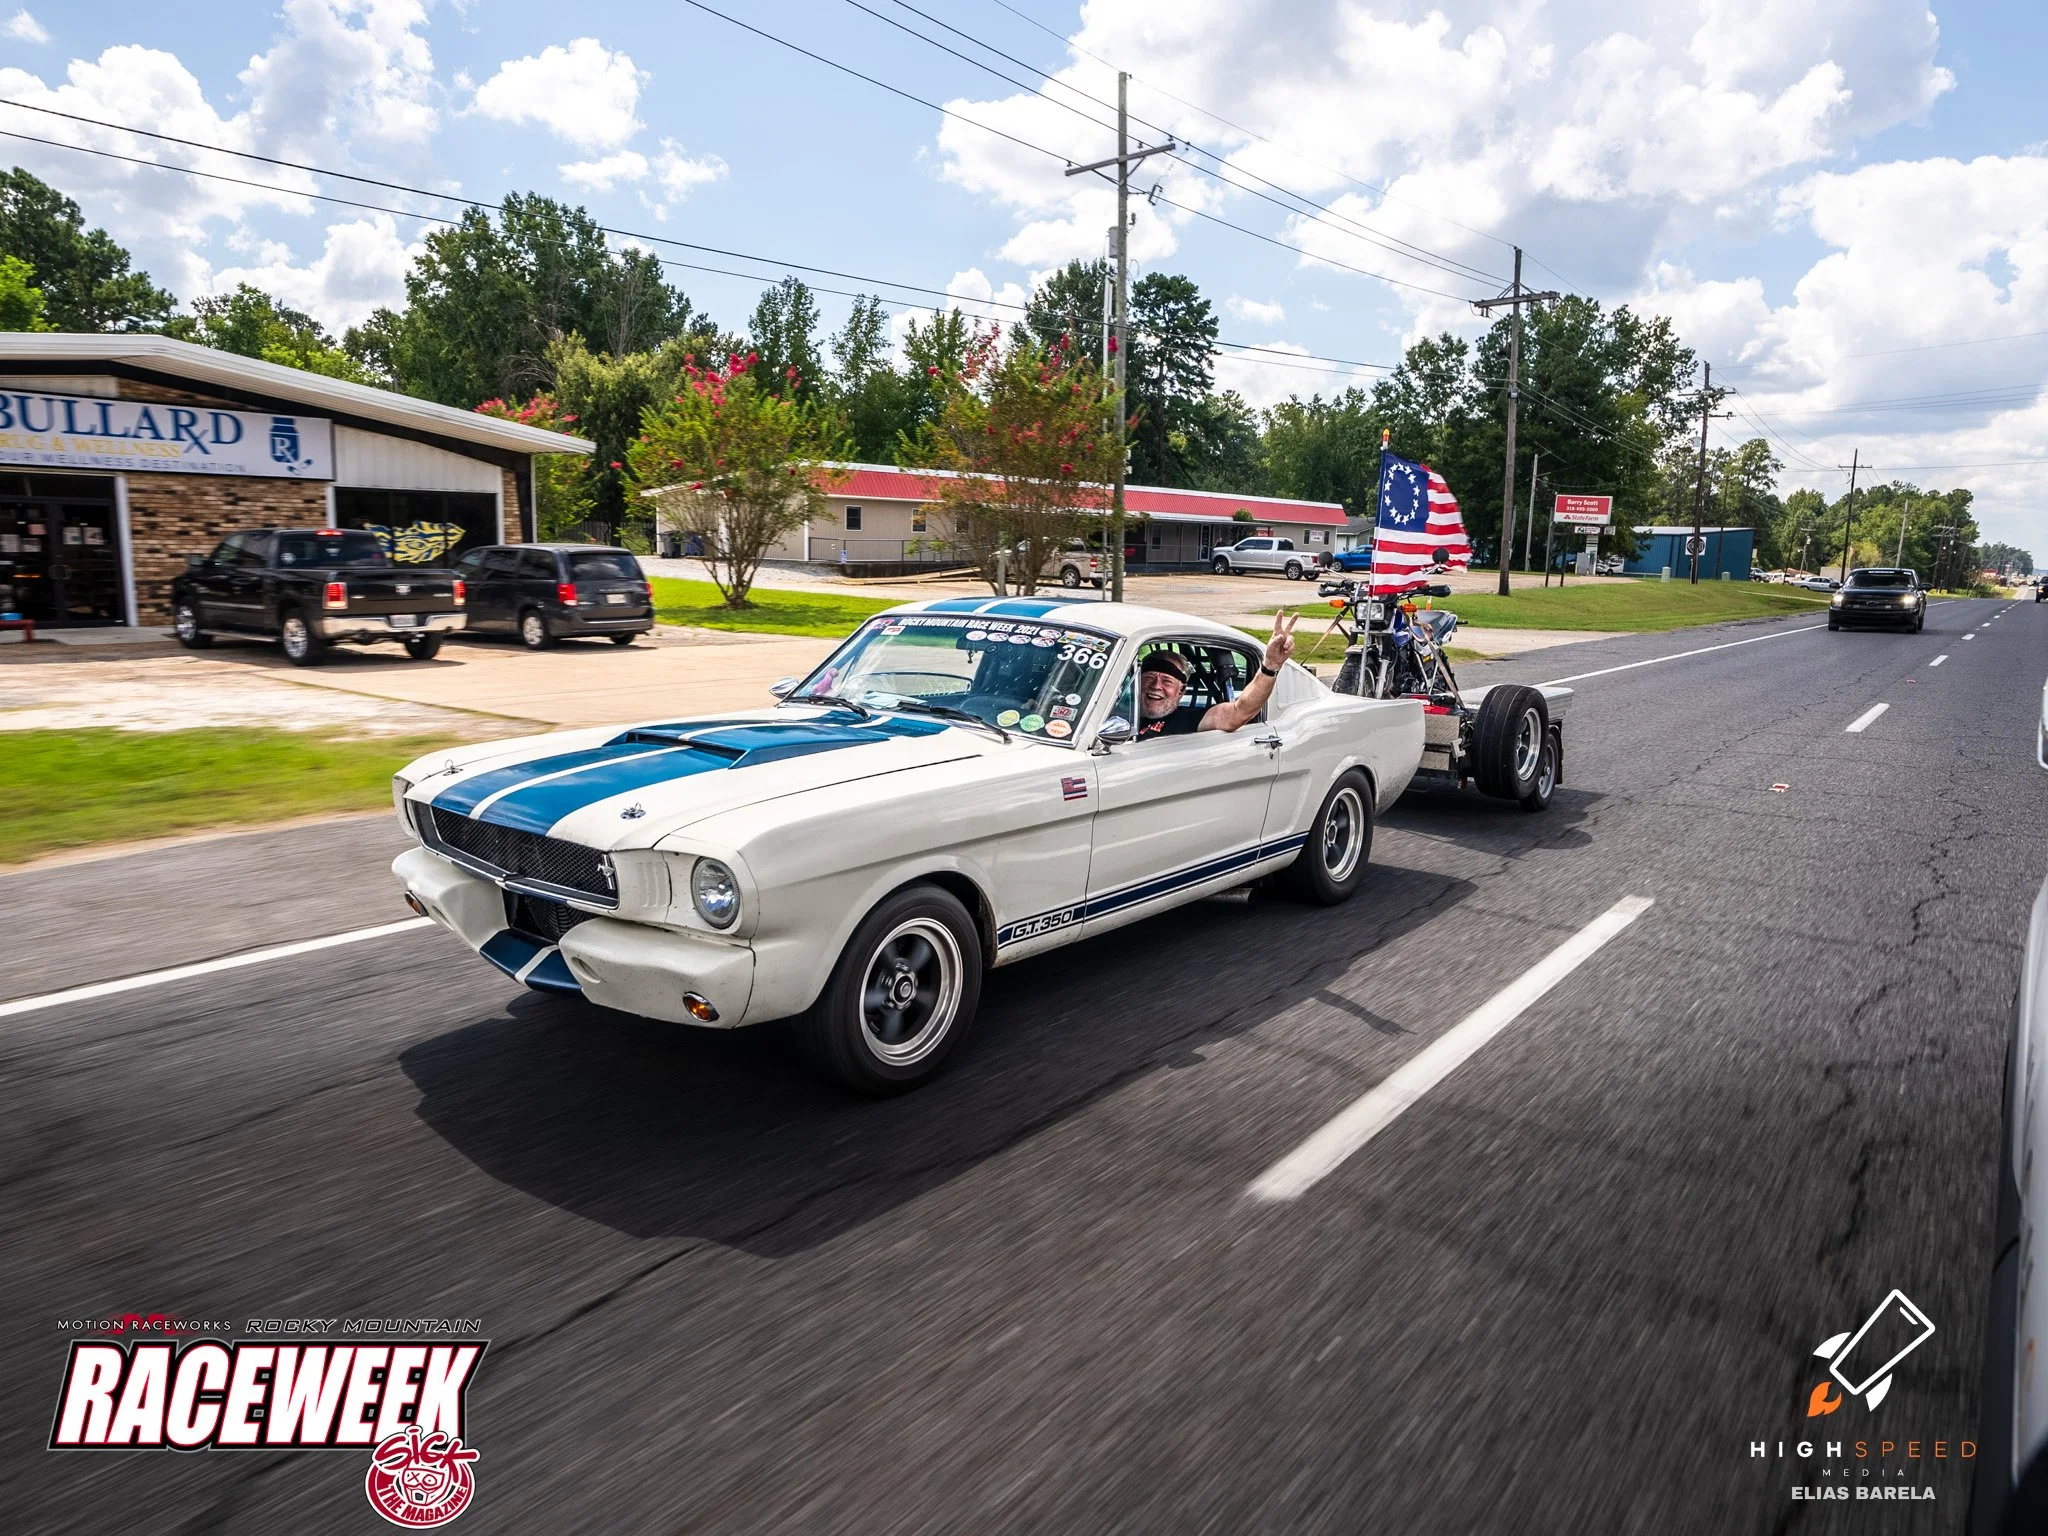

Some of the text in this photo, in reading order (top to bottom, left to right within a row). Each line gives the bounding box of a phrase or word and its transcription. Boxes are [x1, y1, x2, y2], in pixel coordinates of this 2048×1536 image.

[71, 438, 181, 458] WELLNESS
[39, 453, 134, 468] WELLNESS
[140, 458, 248, 473] DESTINATION
[898, 618, 924, 627] ROCKY
[922, 619, 968, 628] MOUNTAIN
[966, 621, 990, 630] RACE
[988, 622, 1016, 633] WEEK
[1015, 625, 1041, 636] 2021
[1057, 644, 1108, 670] 366
